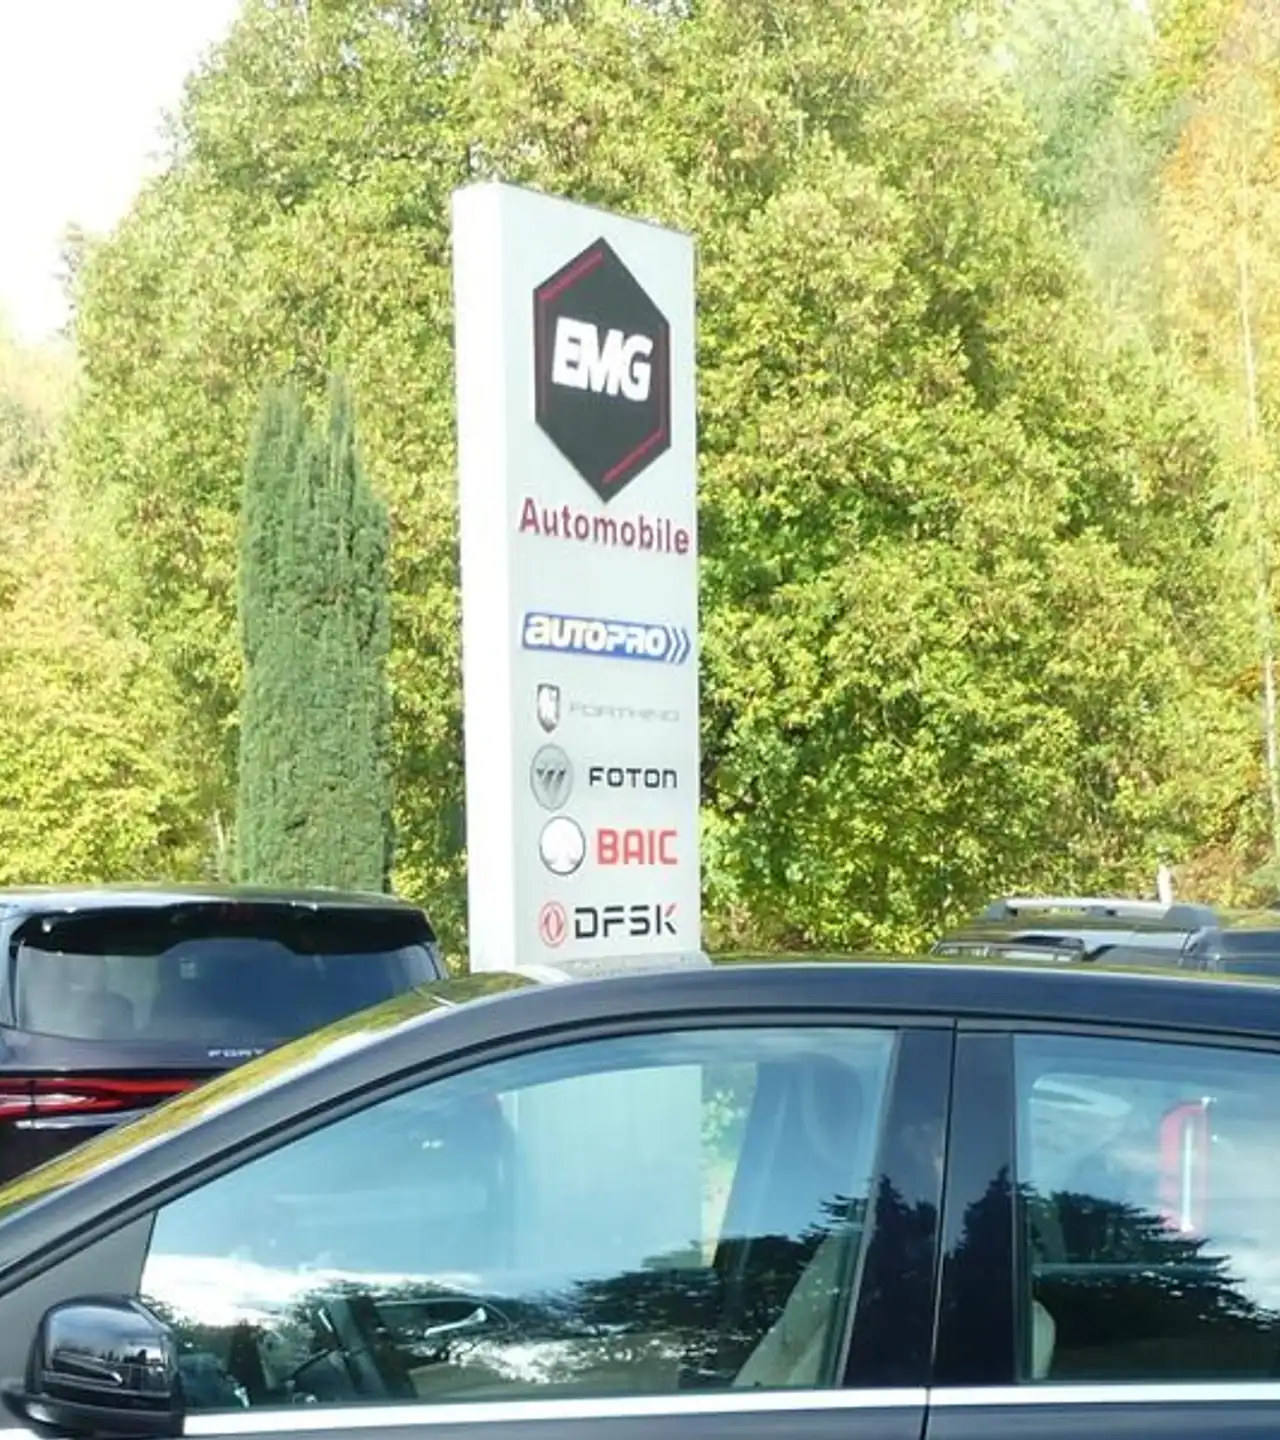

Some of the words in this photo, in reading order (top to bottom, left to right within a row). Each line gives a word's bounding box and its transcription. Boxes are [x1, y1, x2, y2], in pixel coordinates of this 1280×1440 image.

[551, 315, 654, 402] EMG
[519, 498, 690, 556] Automobile
[596, 828, 678, 865] BAIC
[574, 903, 677, 939] DFSK
